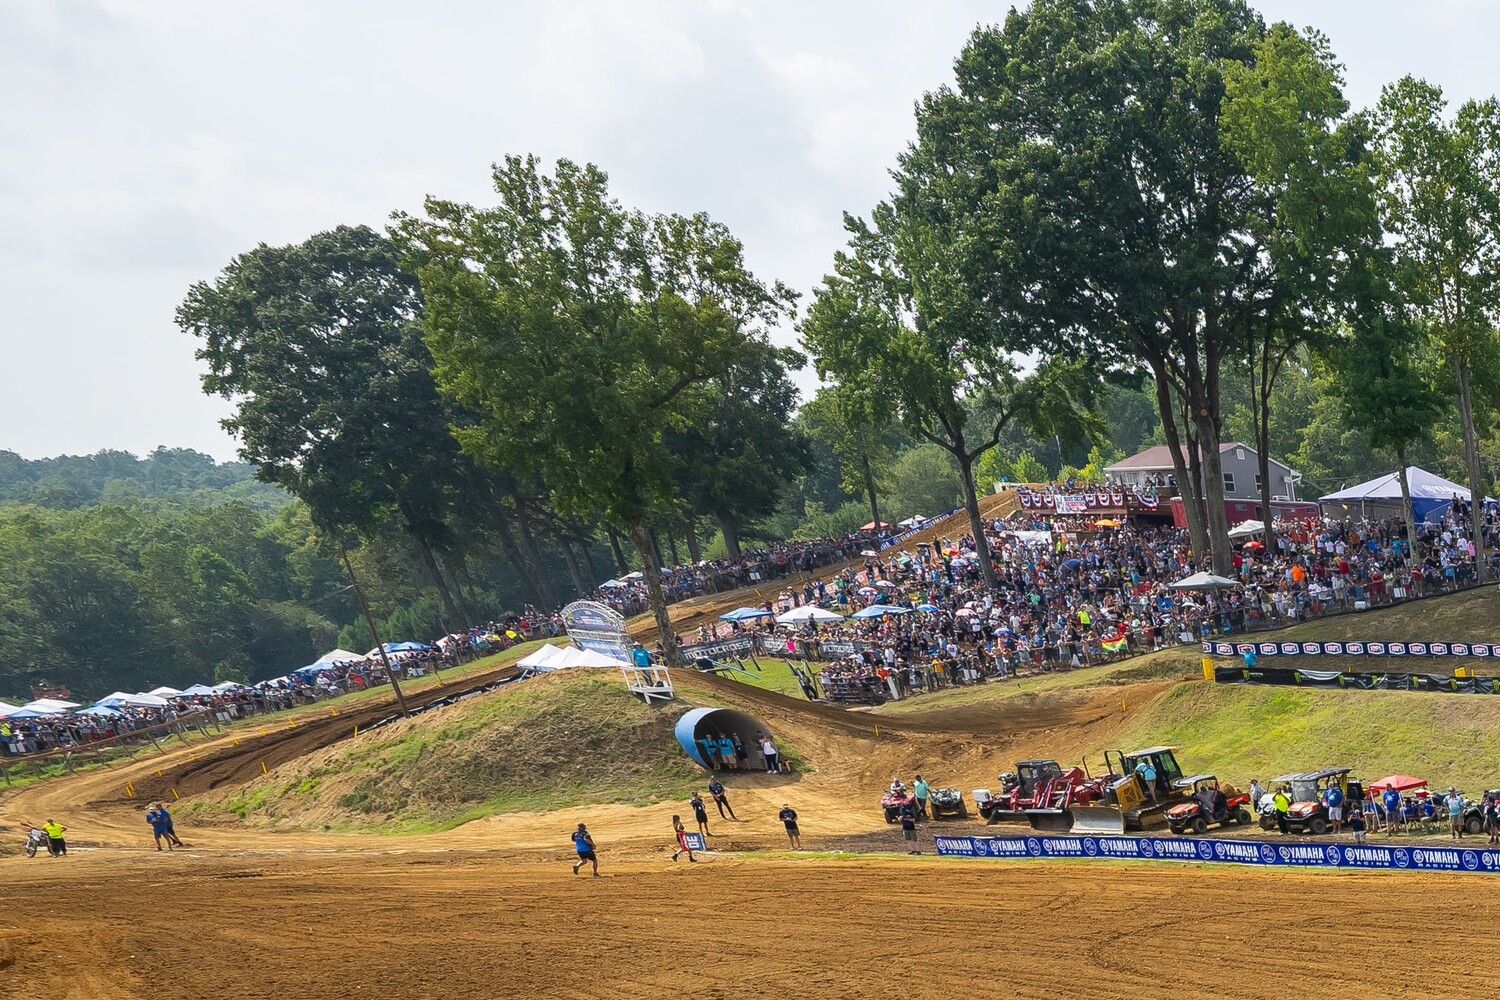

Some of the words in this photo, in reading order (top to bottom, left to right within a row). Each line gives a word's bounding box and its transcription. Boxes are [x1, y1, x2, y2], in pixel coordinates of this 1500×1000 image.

[944, 840, 973, 850] YAMAHA
[995, 840, 1027, 851] YAMAHA
[1050, 840, 1082, 851] YAMAHA
[1107, 840, 1138, 852] YAMAHA
[1163, 841, 1196, 853] YAMAHA
[1224, 844, 1259, 857] YAMAHA
[1290, 848, 1324, 859] YAMAHA
[1354, 849, 1390, 862] YAMAHA
[1423, 850, 1460, 864] YAMAHA
